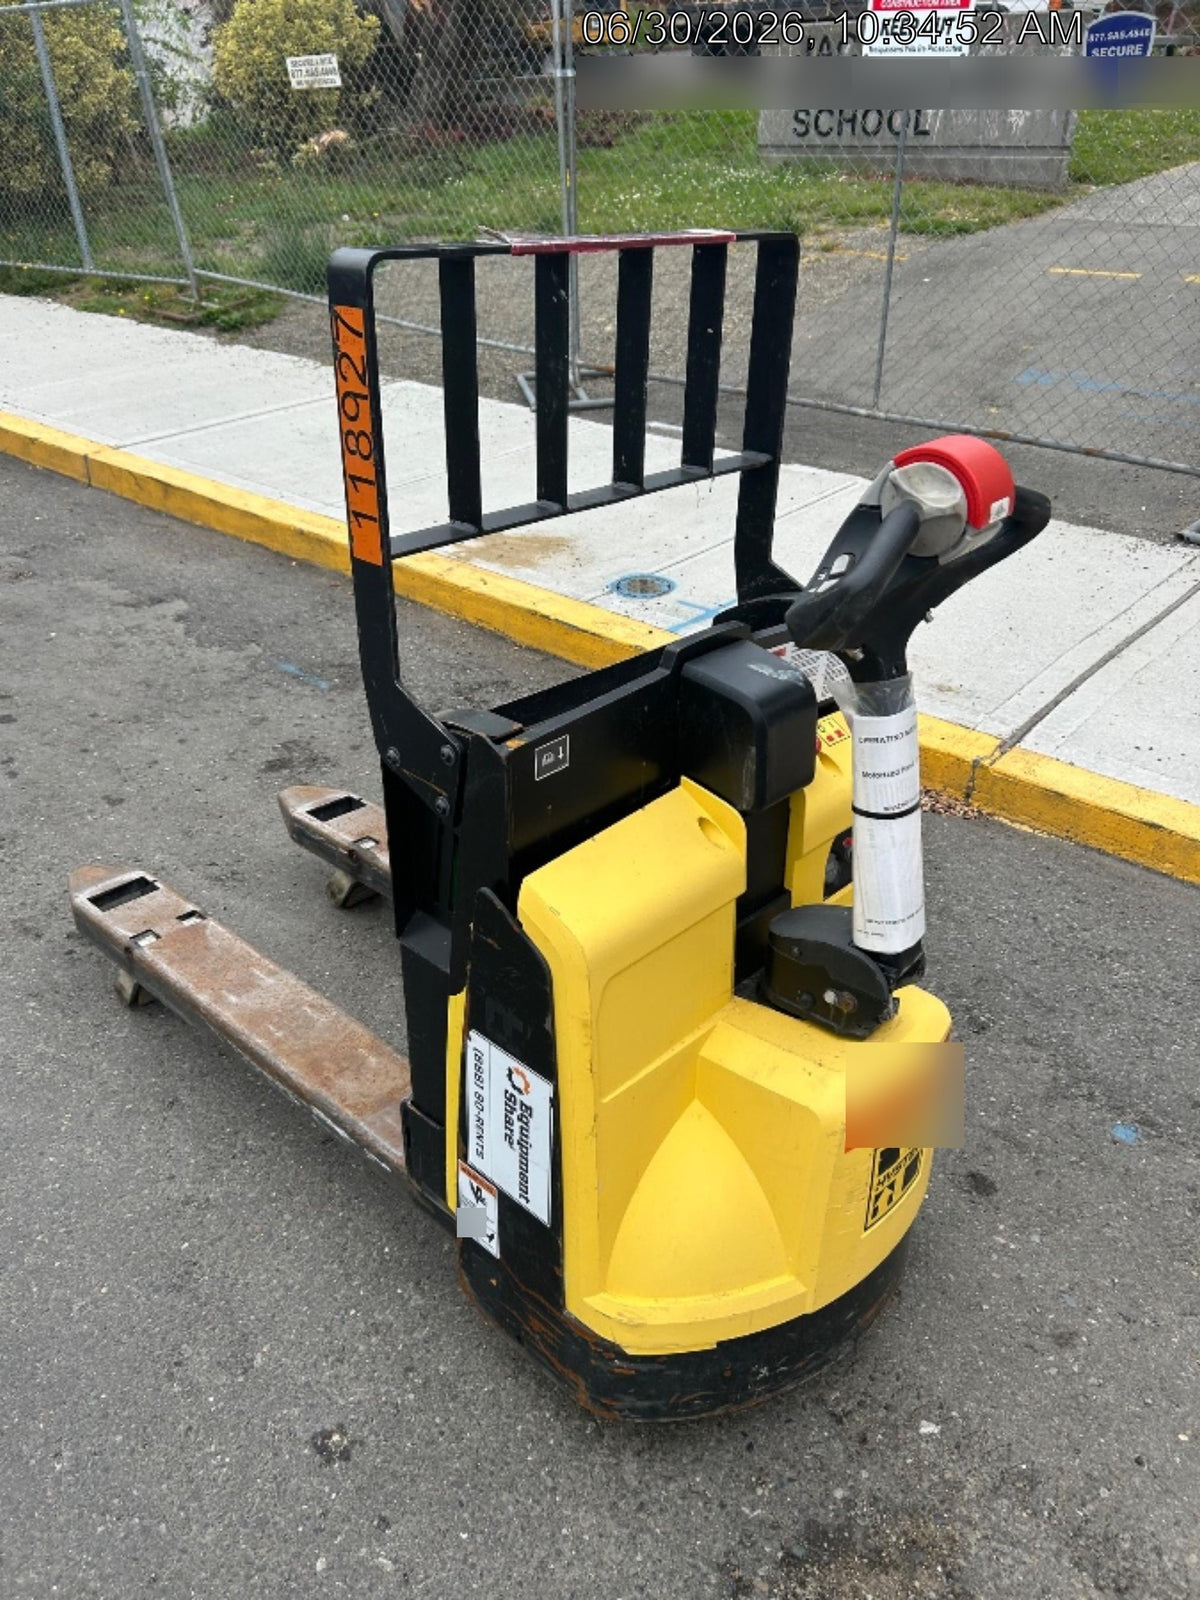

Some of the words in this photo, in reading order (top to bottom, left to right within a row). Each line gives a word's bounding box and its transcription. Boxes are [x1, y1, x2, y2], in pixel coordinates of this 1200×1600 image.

[1092, 44, 1144, 56] SECURE
[792, 109, 931, 137] SCHOOL
[331, 308, 378, 529] 118927
[503, 1089, 517, 1147] Share
[517, 1101, 533, 1205] Equipment
